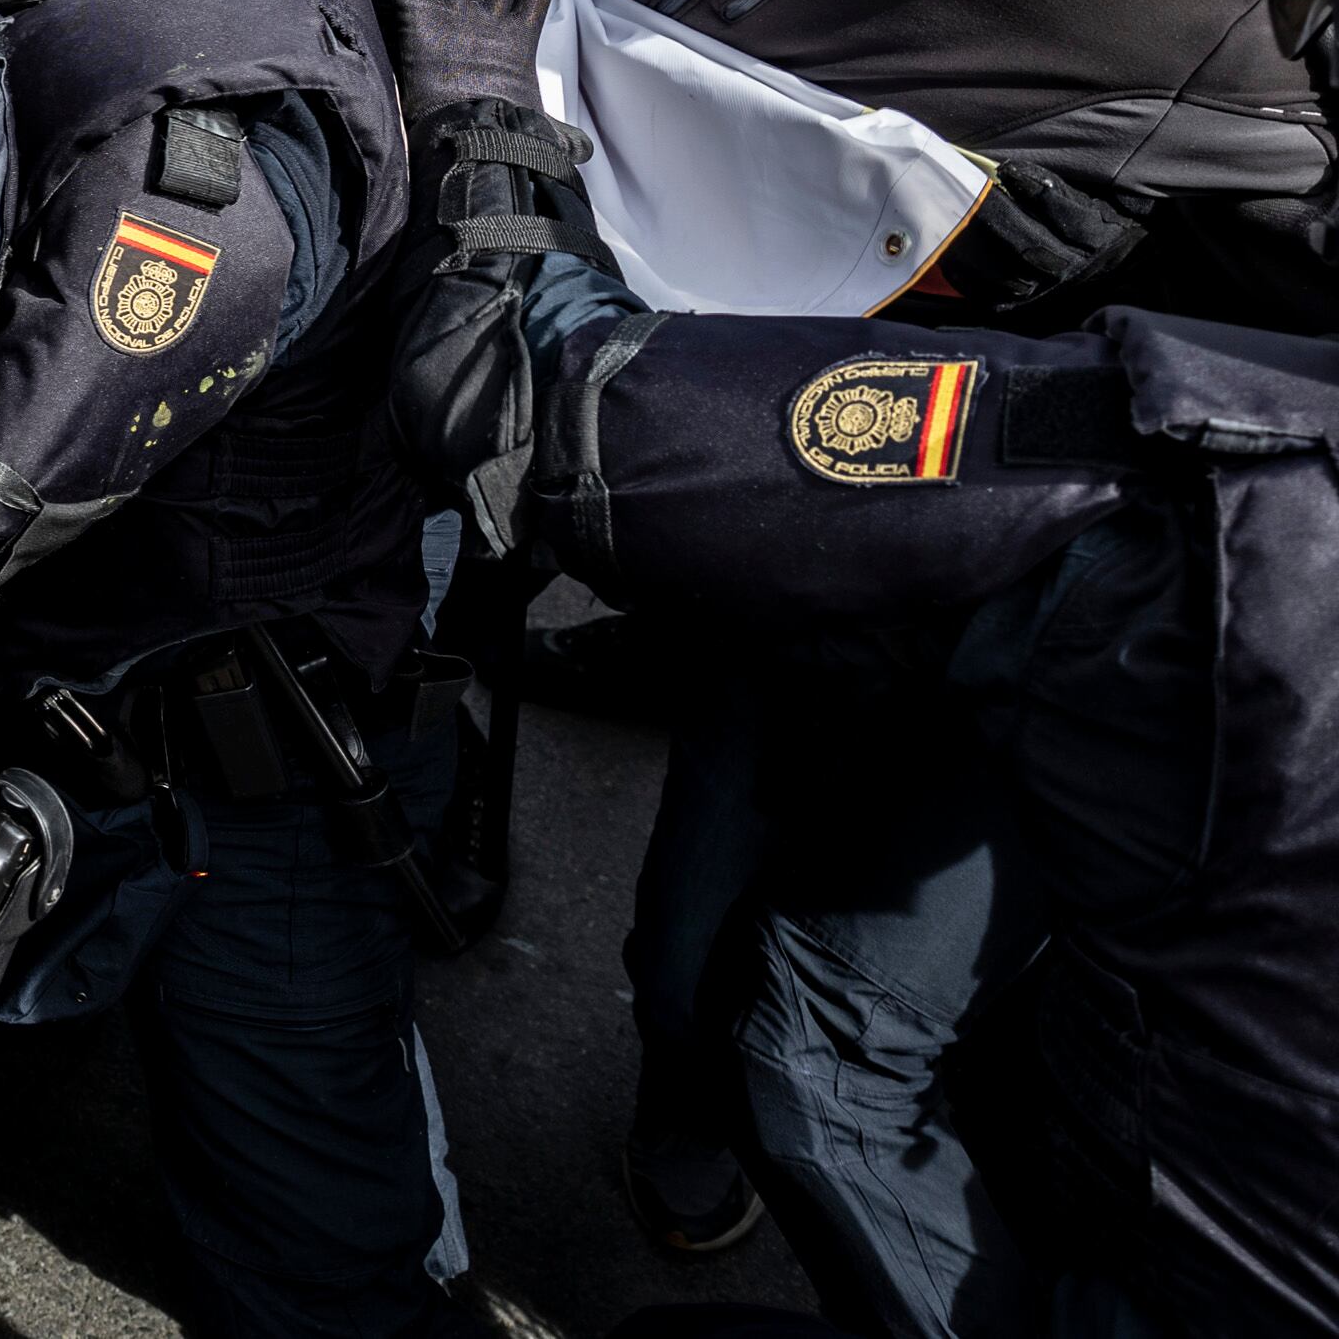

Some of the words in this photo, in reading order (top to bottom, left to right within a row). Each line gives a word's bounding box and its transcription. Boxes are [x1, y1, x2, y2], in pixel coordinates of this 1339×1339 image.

[98, 245, 125, 307] CUERPO
[174, 277, 206, 331] POLICIA
[99, 308, 153, 349] NACIONAL
[154, 328, 176, 345] DE
[843, 367, 929, 381] CUERPO
[797, 373, 844, 447] NACIONAL
[808, 446, 835, 468] DE
[834, 462, 911, 476] POLICIA
